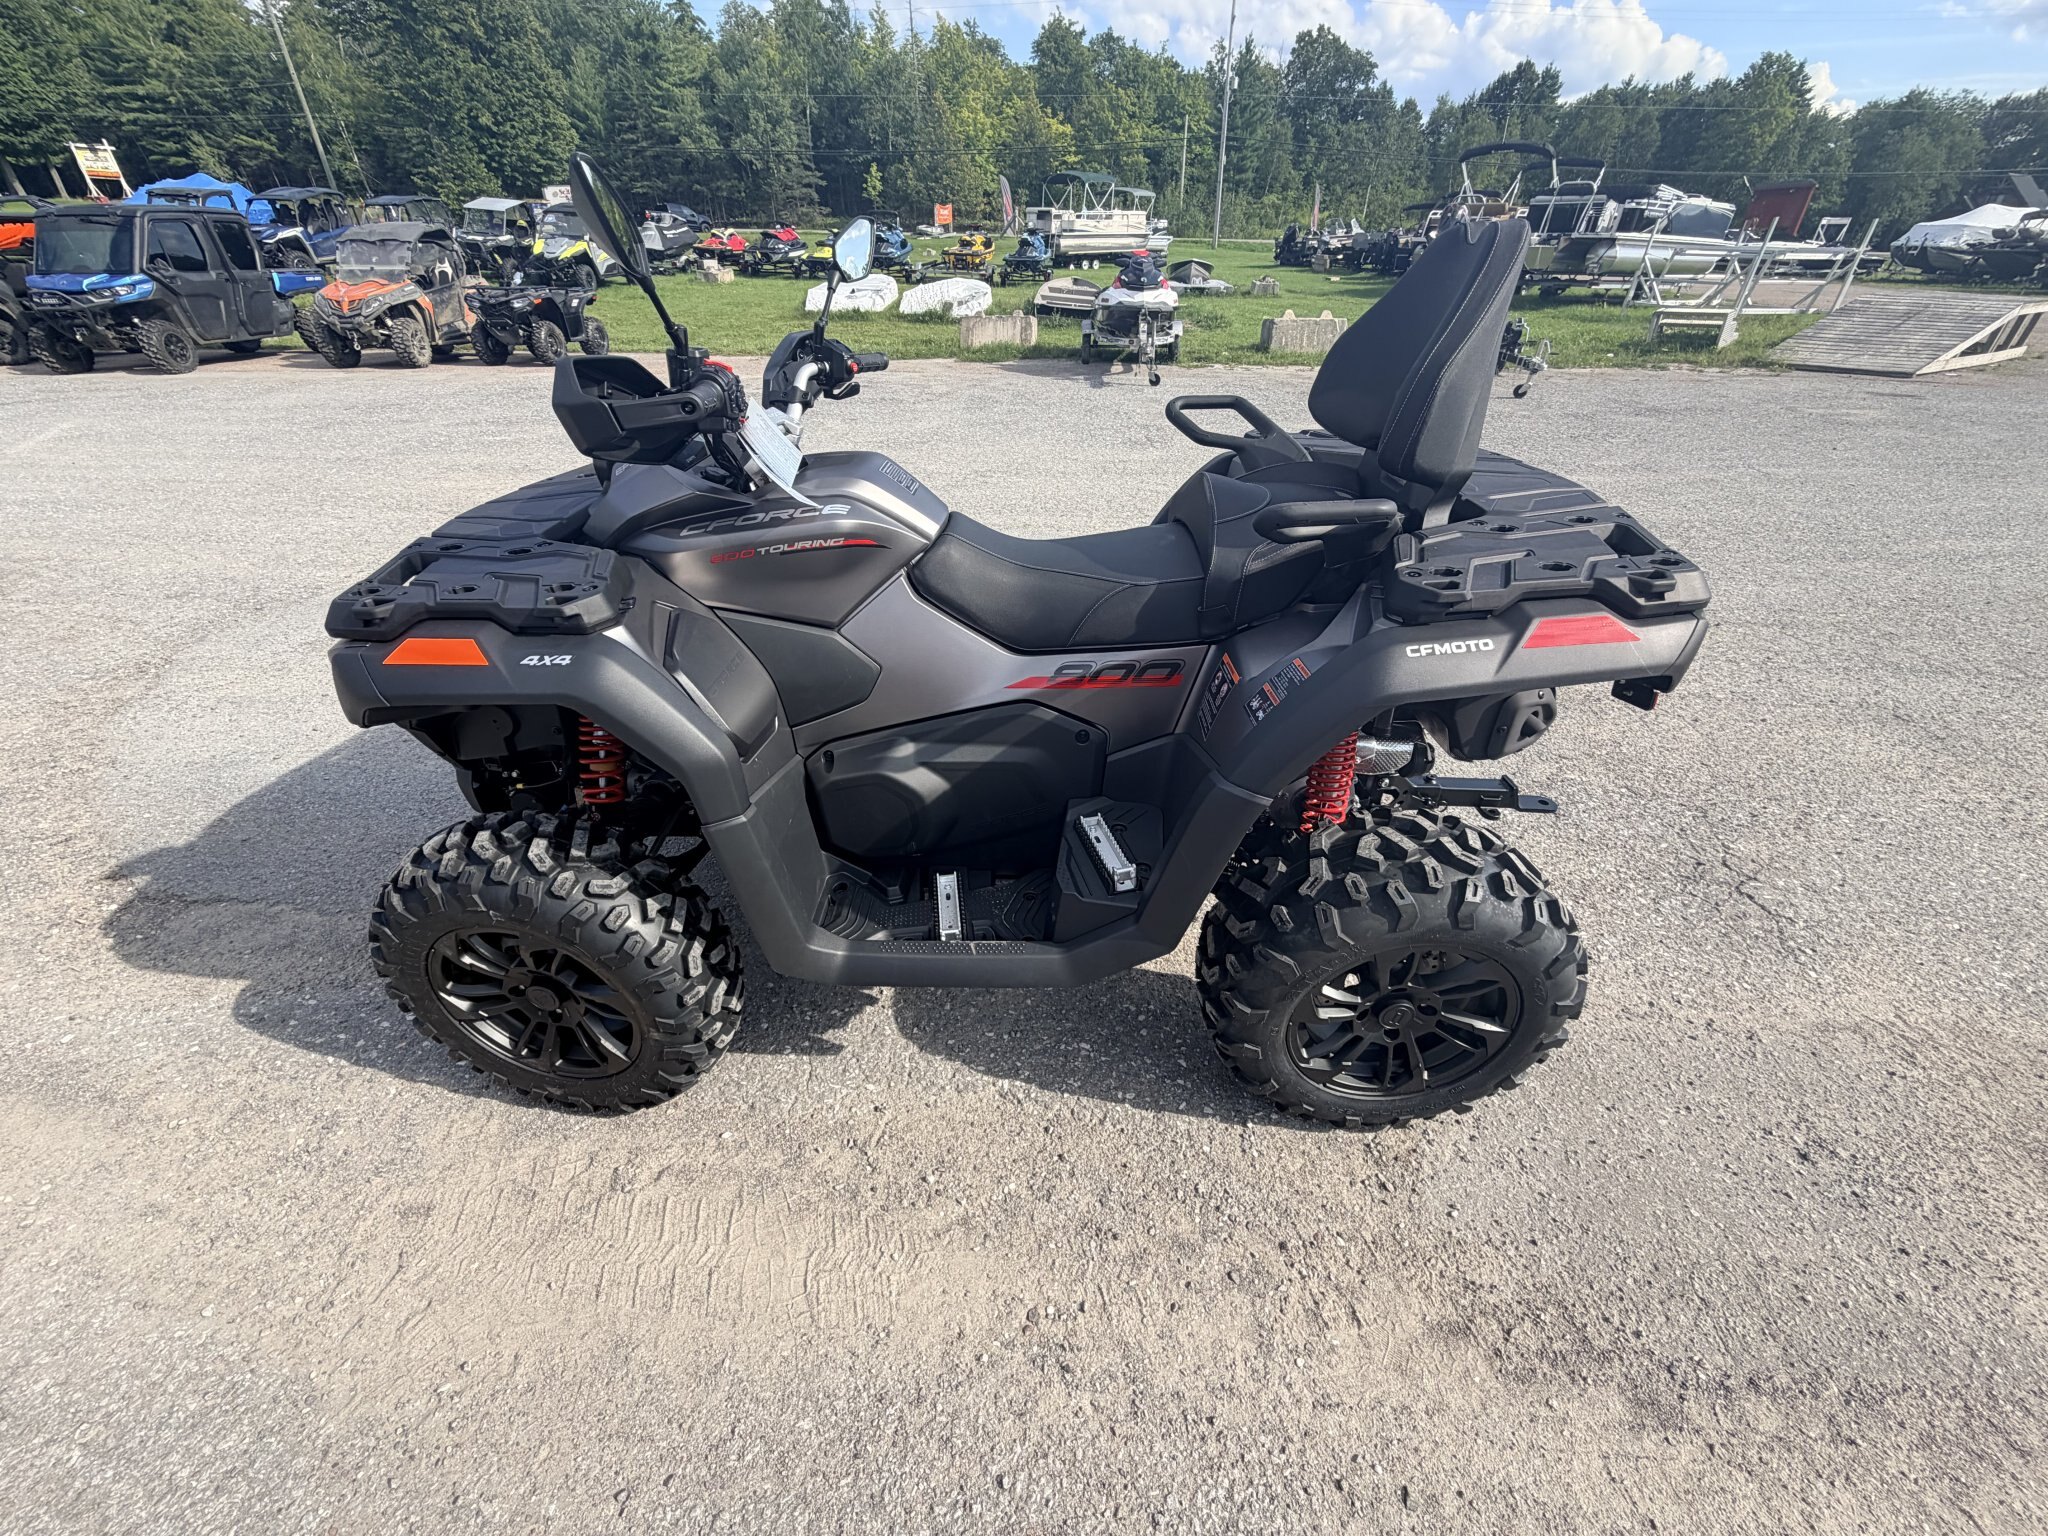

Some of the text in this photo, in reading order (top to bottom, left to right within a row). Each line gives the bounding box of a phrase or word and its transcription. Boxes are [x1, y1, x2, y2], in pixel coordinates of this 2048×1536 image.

[680, 504, 852, 537] CFORCE
[756, 537, 845, 556] TOURING
[1405, 638, 1495, 658] CFMOTO
